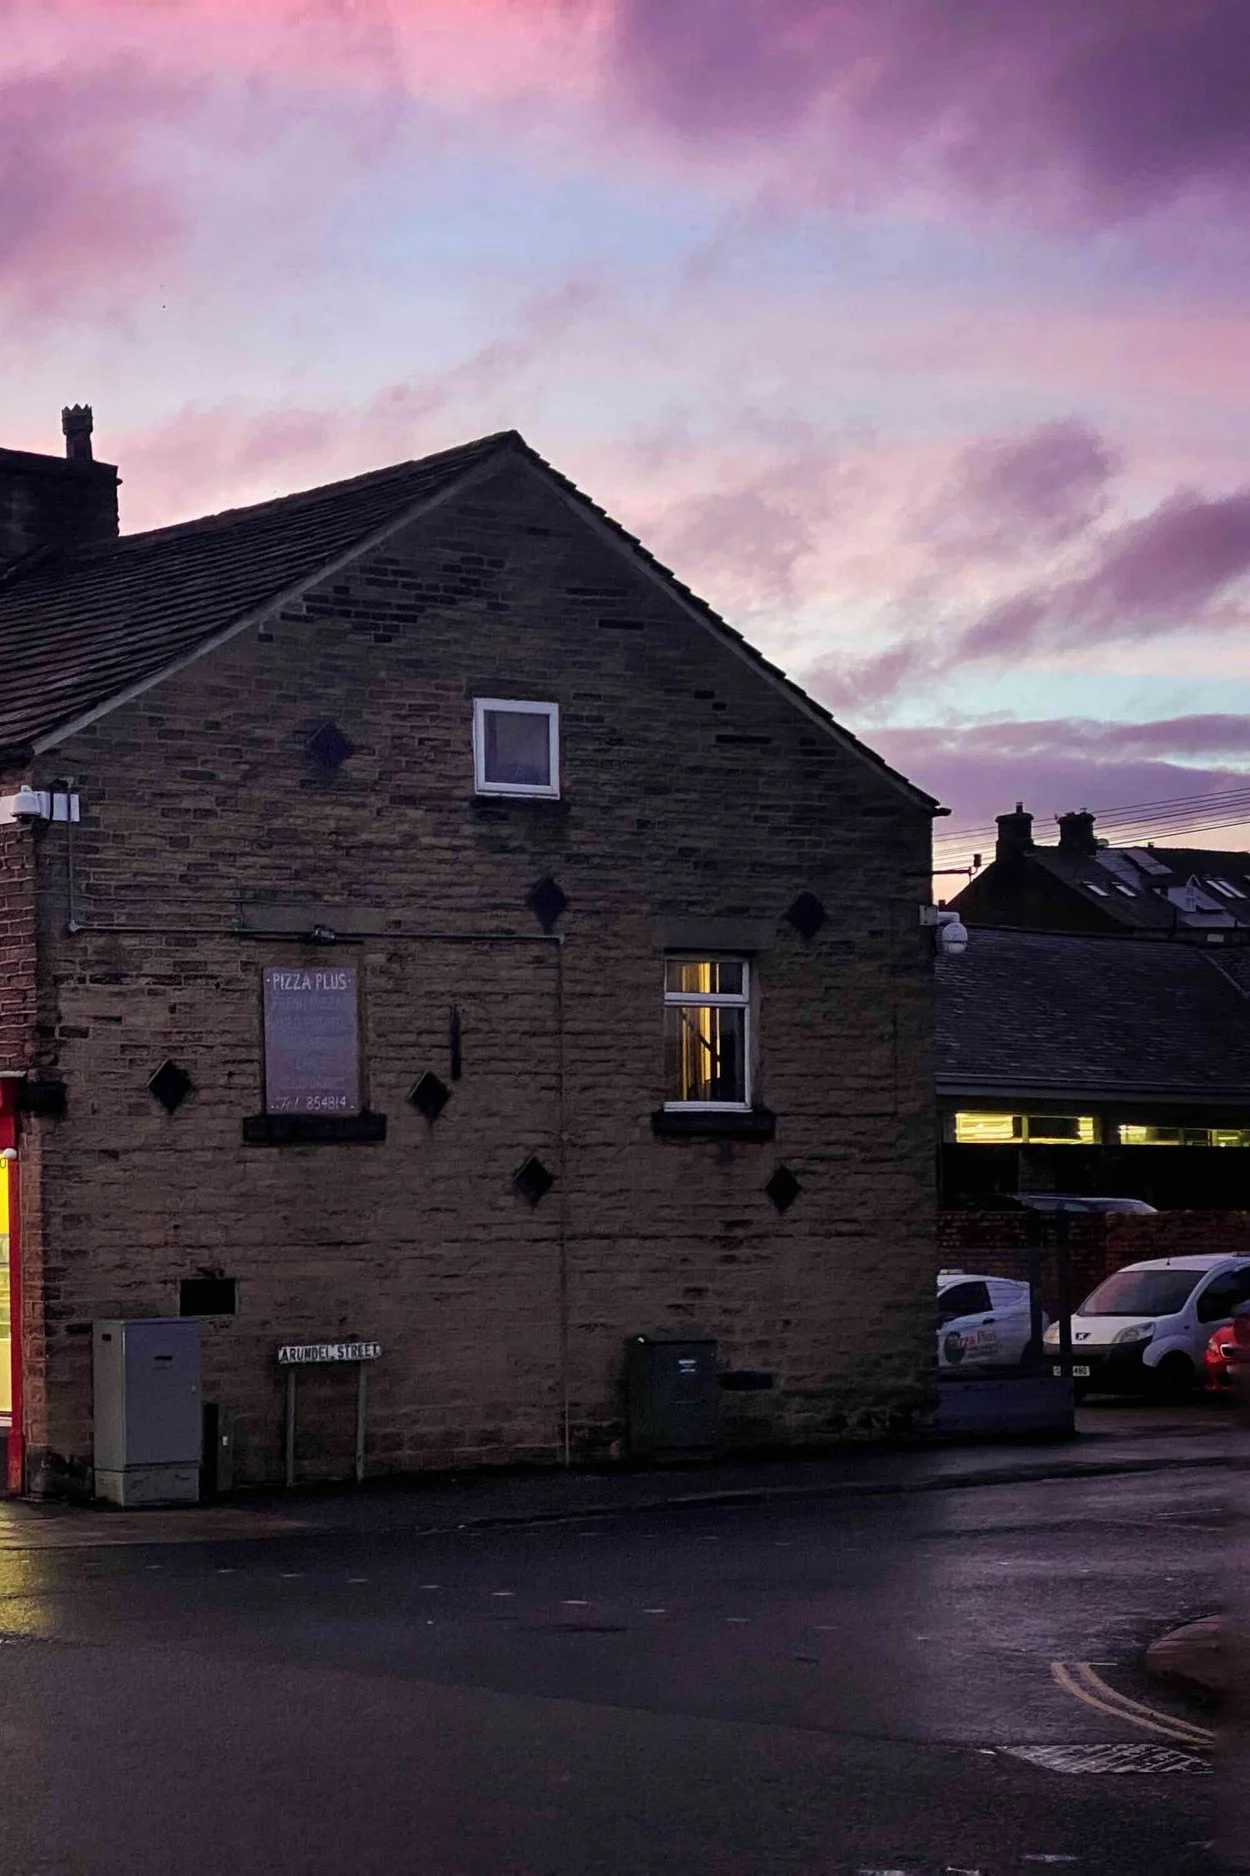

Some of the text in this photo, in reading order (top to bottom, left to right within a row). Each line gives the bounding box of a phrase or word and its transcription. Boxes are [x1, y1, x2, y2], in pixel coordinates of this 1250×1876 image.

[272, 973, 347, 990] PIZZA PLUS
[306, 1096, 346, 1110] 854814
[280, 1343, 378, 1361] ARUNDEL STREET
